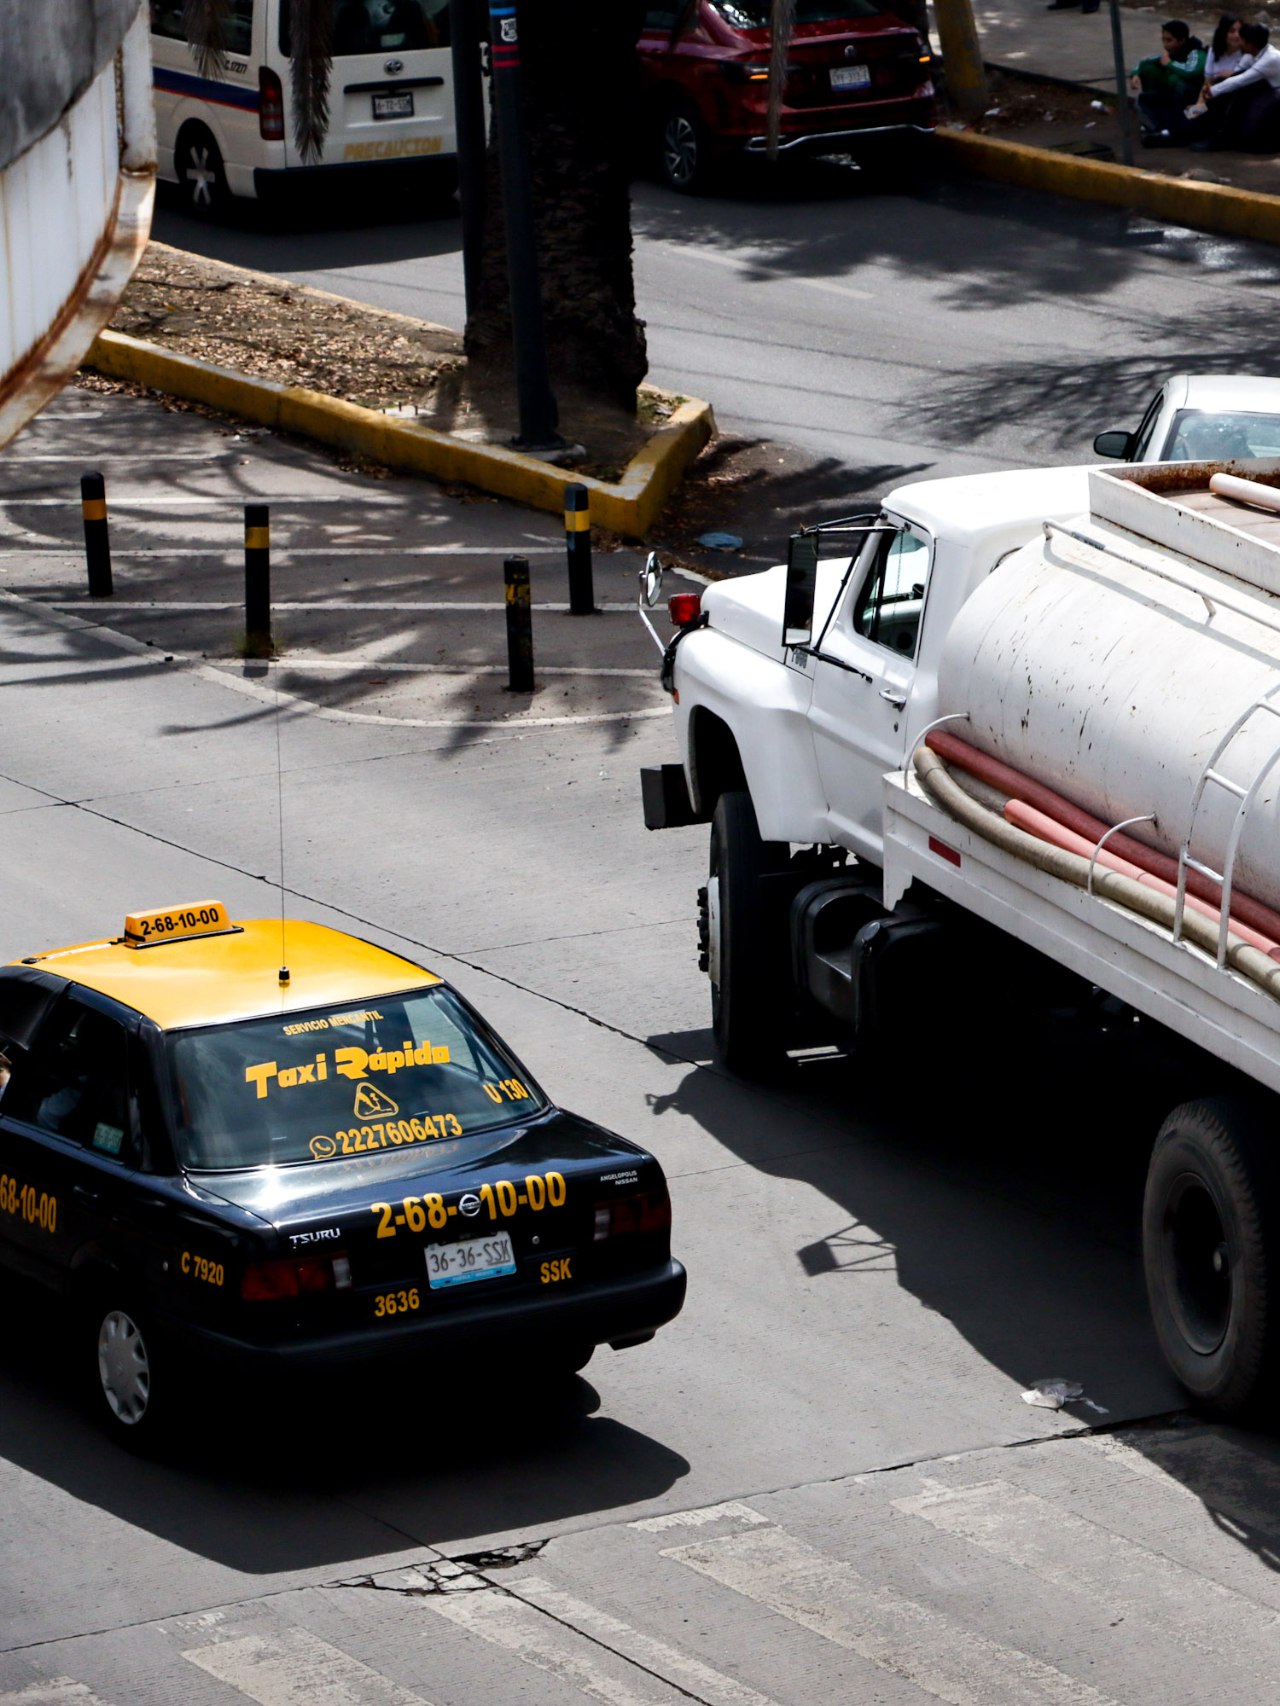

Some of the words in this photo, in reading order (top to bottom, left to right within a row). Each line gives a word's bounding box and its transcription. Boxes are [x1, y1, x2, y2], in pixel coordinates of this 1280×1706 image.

[140, 907, 220, 936] 2-68-10-00
[282, 1018, 330, 1036] SERVICIO
[327, 1010, 384, 1027] MERCANTIL
[245, 1053, 328, 1099] Taxi
[482, 1083, 503, 1104] U
[499, 1078, 529, 1100] 130
[335, 1113, 463, 1155] 2227606473
[615, 1177, 638, 1185] NISSAN
[289, 1228, 341, 1244] TSURU
[181, 1251, 190, 1274] C
[193, 1255, 224, 1287] 7920
[430, 1239, 511, 1273] 36-36-SSK
[540, 1258, 573, 1284] SSK
[374, 1288, 420, 1317] 3636
